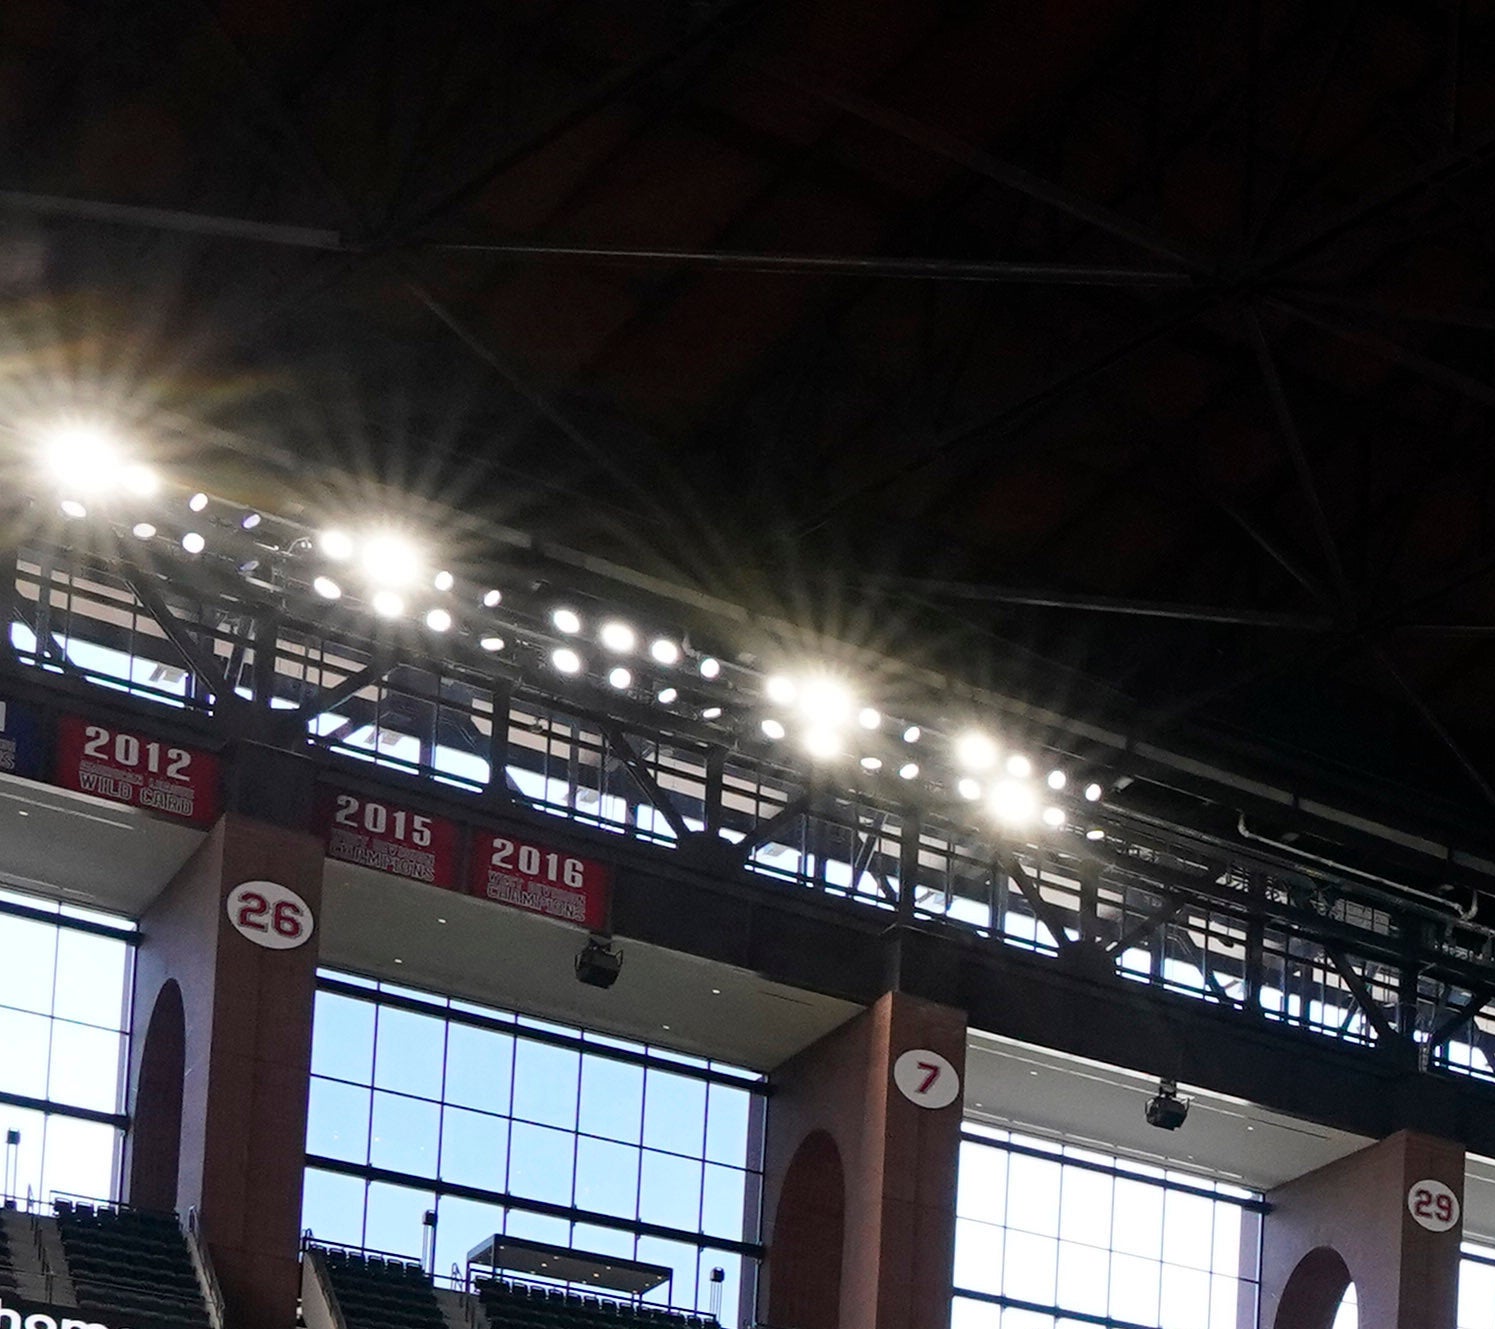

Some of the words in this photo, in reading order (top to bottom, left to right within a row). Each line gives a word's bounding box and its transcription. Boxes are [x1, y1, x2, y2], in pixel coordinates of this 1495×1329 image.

[84, 726, 192, 781] 2012
[79, 772, 132, 800] WILD
[335, 795, 431, 847] 2015
[491, 838, 584, 888] 2016
[237, 890, 305, 940] 26
[914, 1064, 939, 1093] 7
[1414, 1191, 1453, 1222] 29
